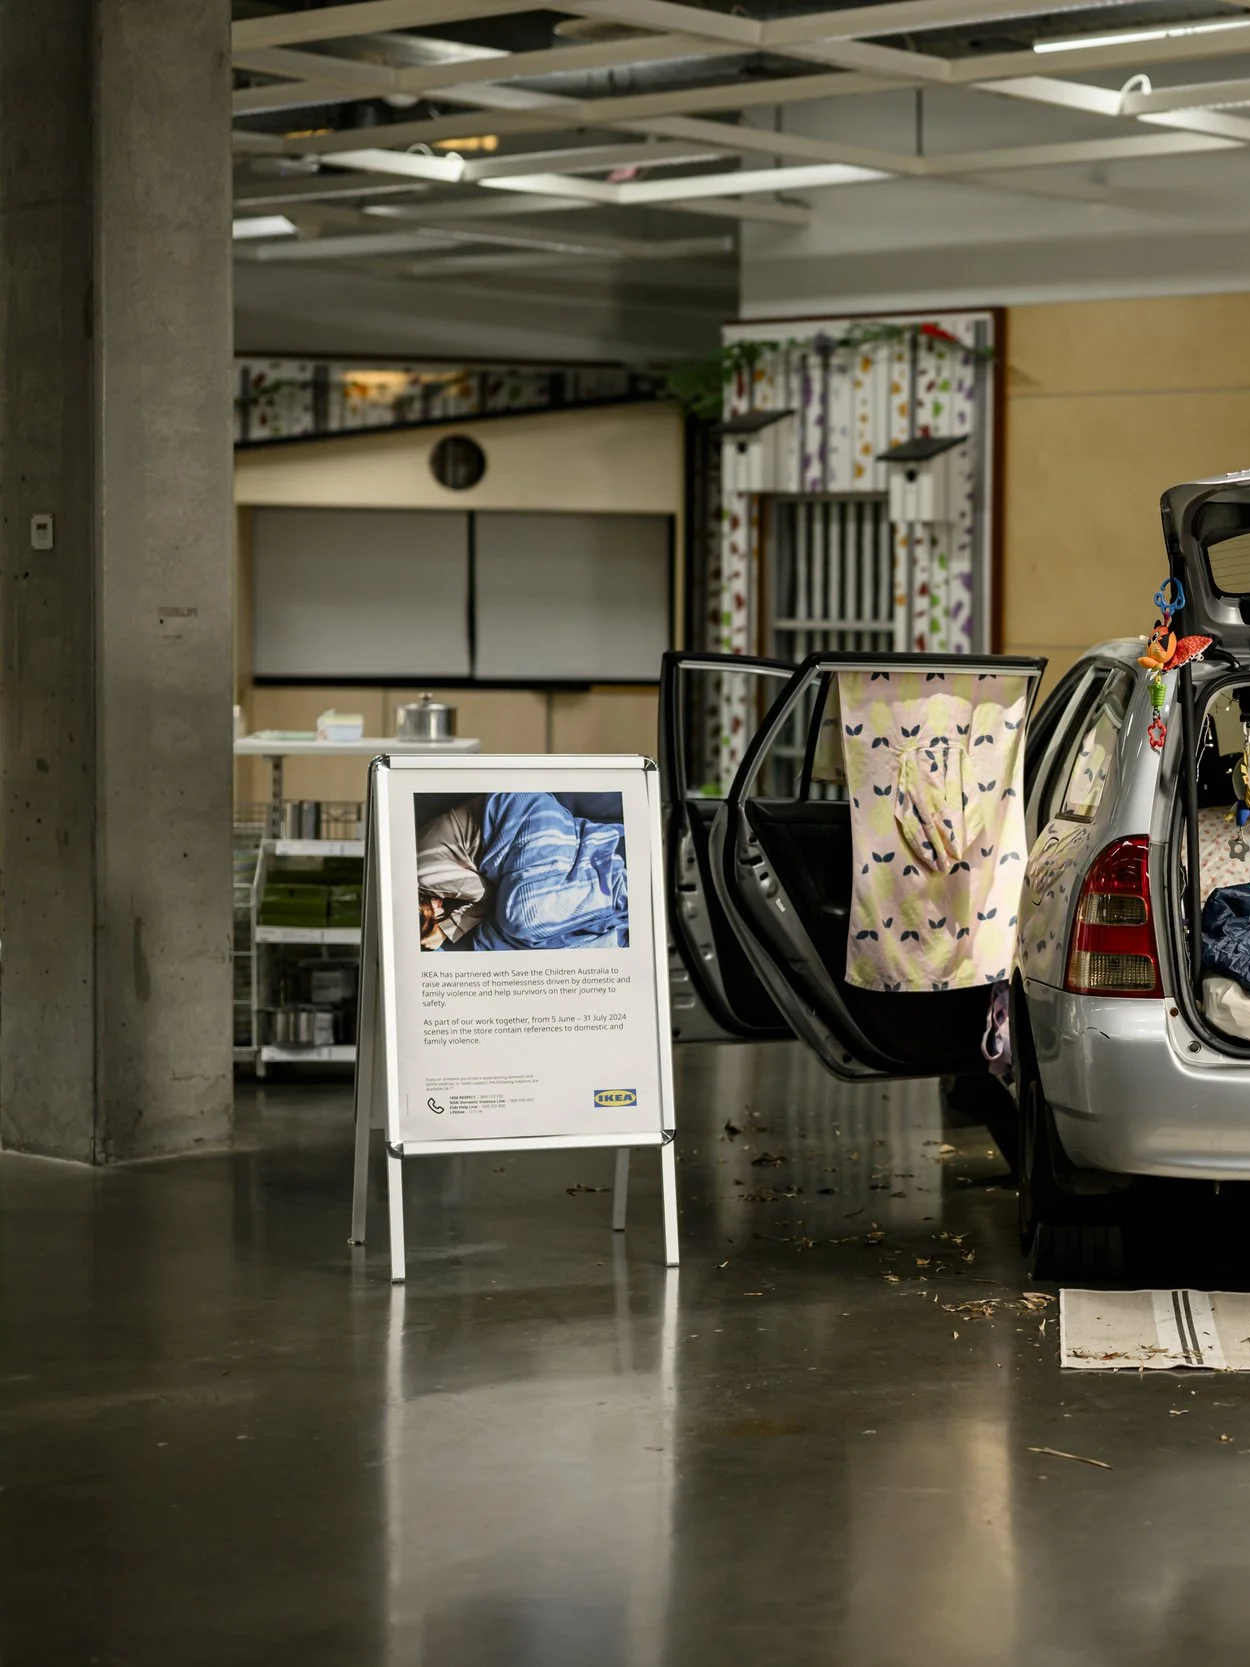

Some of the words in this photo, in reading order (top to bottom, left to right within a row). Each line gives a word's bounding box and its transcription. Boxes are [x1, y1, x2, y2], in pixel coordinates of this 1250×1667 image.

[422, 970, 438, 978] IKEA
[455, 969, 491, 979] partnered
[531, 968, 543, 976] the
[578, 967, 609, 975] Australia
[492, 978, 544, 986] homelessness
[546, 977, 569, 985] driven
[572, 977, 580, 986] by
[582, 976, 614, 984] domestic
[422, 989, 445, 998] family
[447, 988, 476, 996] violence
[495, 988, 511, 997] help
[513, 987, 546, 995] survivors
[560, 986, 577, 994] their
[579, 986, 606, 995] journey
[423, 999, 446, 1008] safety.
[435, 1017, 449, 1026] part
[476, 1016, 494, 1024] work
[496, 1016, 529, 1025] together,
[558, 1014, 575, 1023] June
[594, 1014, 607, 1023] July
[598, 1094, 633, 1102] IKEA
